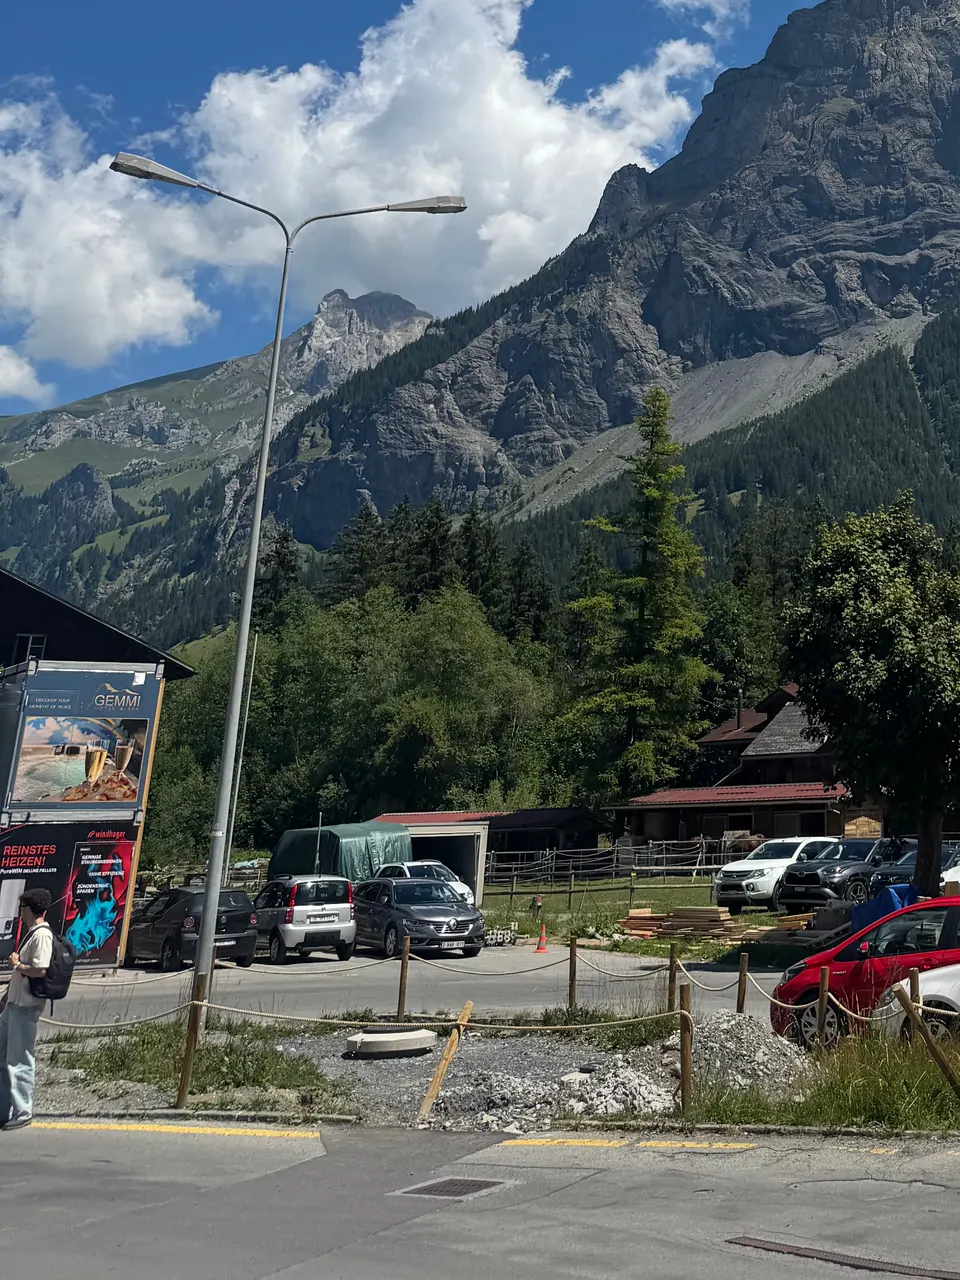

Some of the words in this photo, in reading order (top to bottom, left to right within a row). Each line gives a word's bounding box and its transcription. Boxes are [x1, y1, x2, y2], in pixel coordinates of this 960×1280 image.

[95, 695, 141, 707] GEMMI
[95, 830, 126, 840] windhager
[3, 845, 57, 855] REINSTES
[1, 856, 46, 867] HEIZEN!
